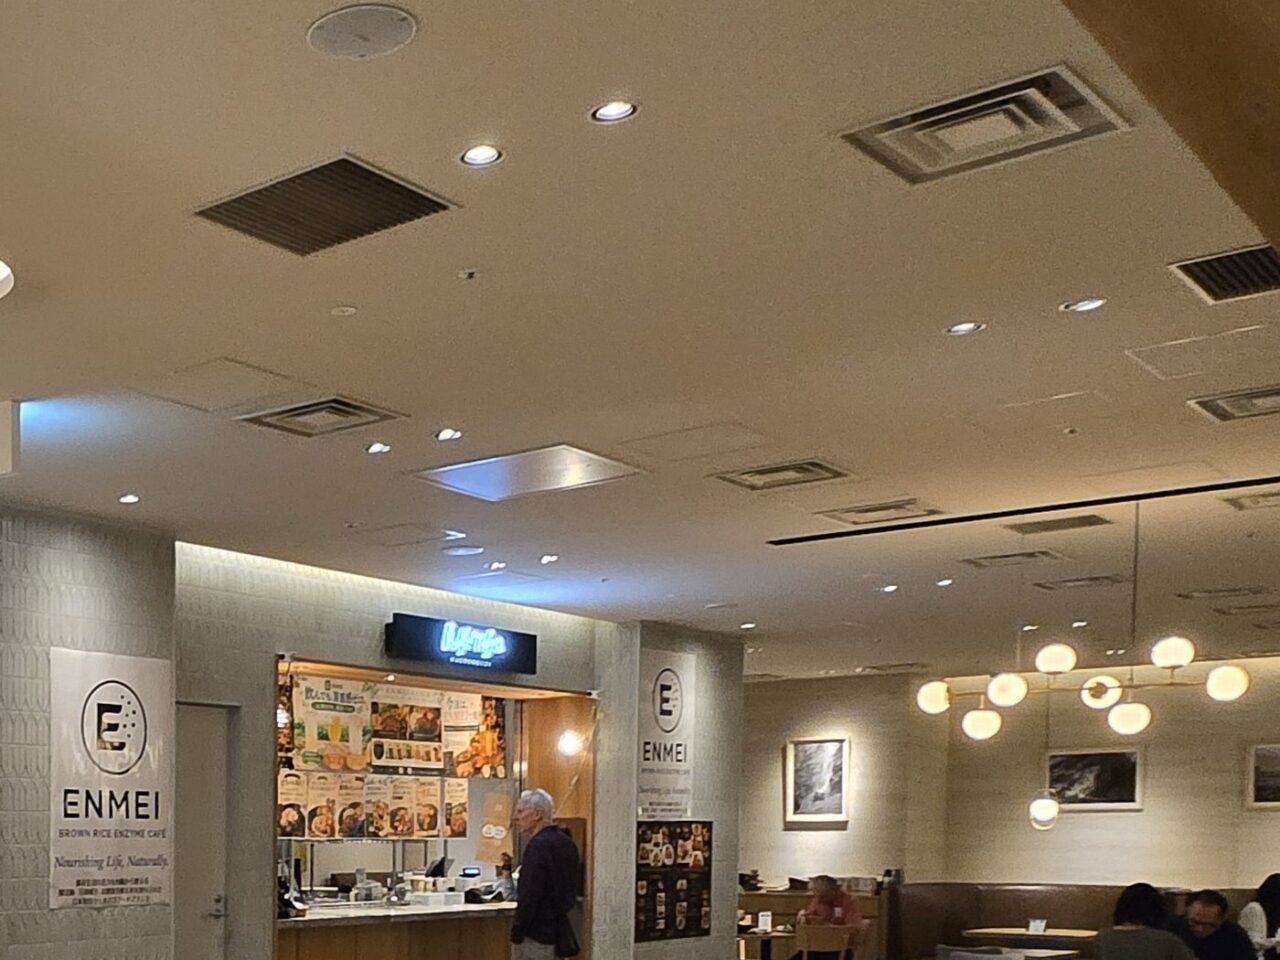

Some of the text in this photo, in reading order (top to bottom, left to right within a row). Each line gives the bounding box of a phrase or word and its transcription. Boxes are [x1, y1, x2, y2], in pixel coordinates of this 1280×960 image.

[642, 741, 688, 763] ENMEI
[63, 788, 159, 820] ENMEI
[58, 829, 91, 839] BROWN
